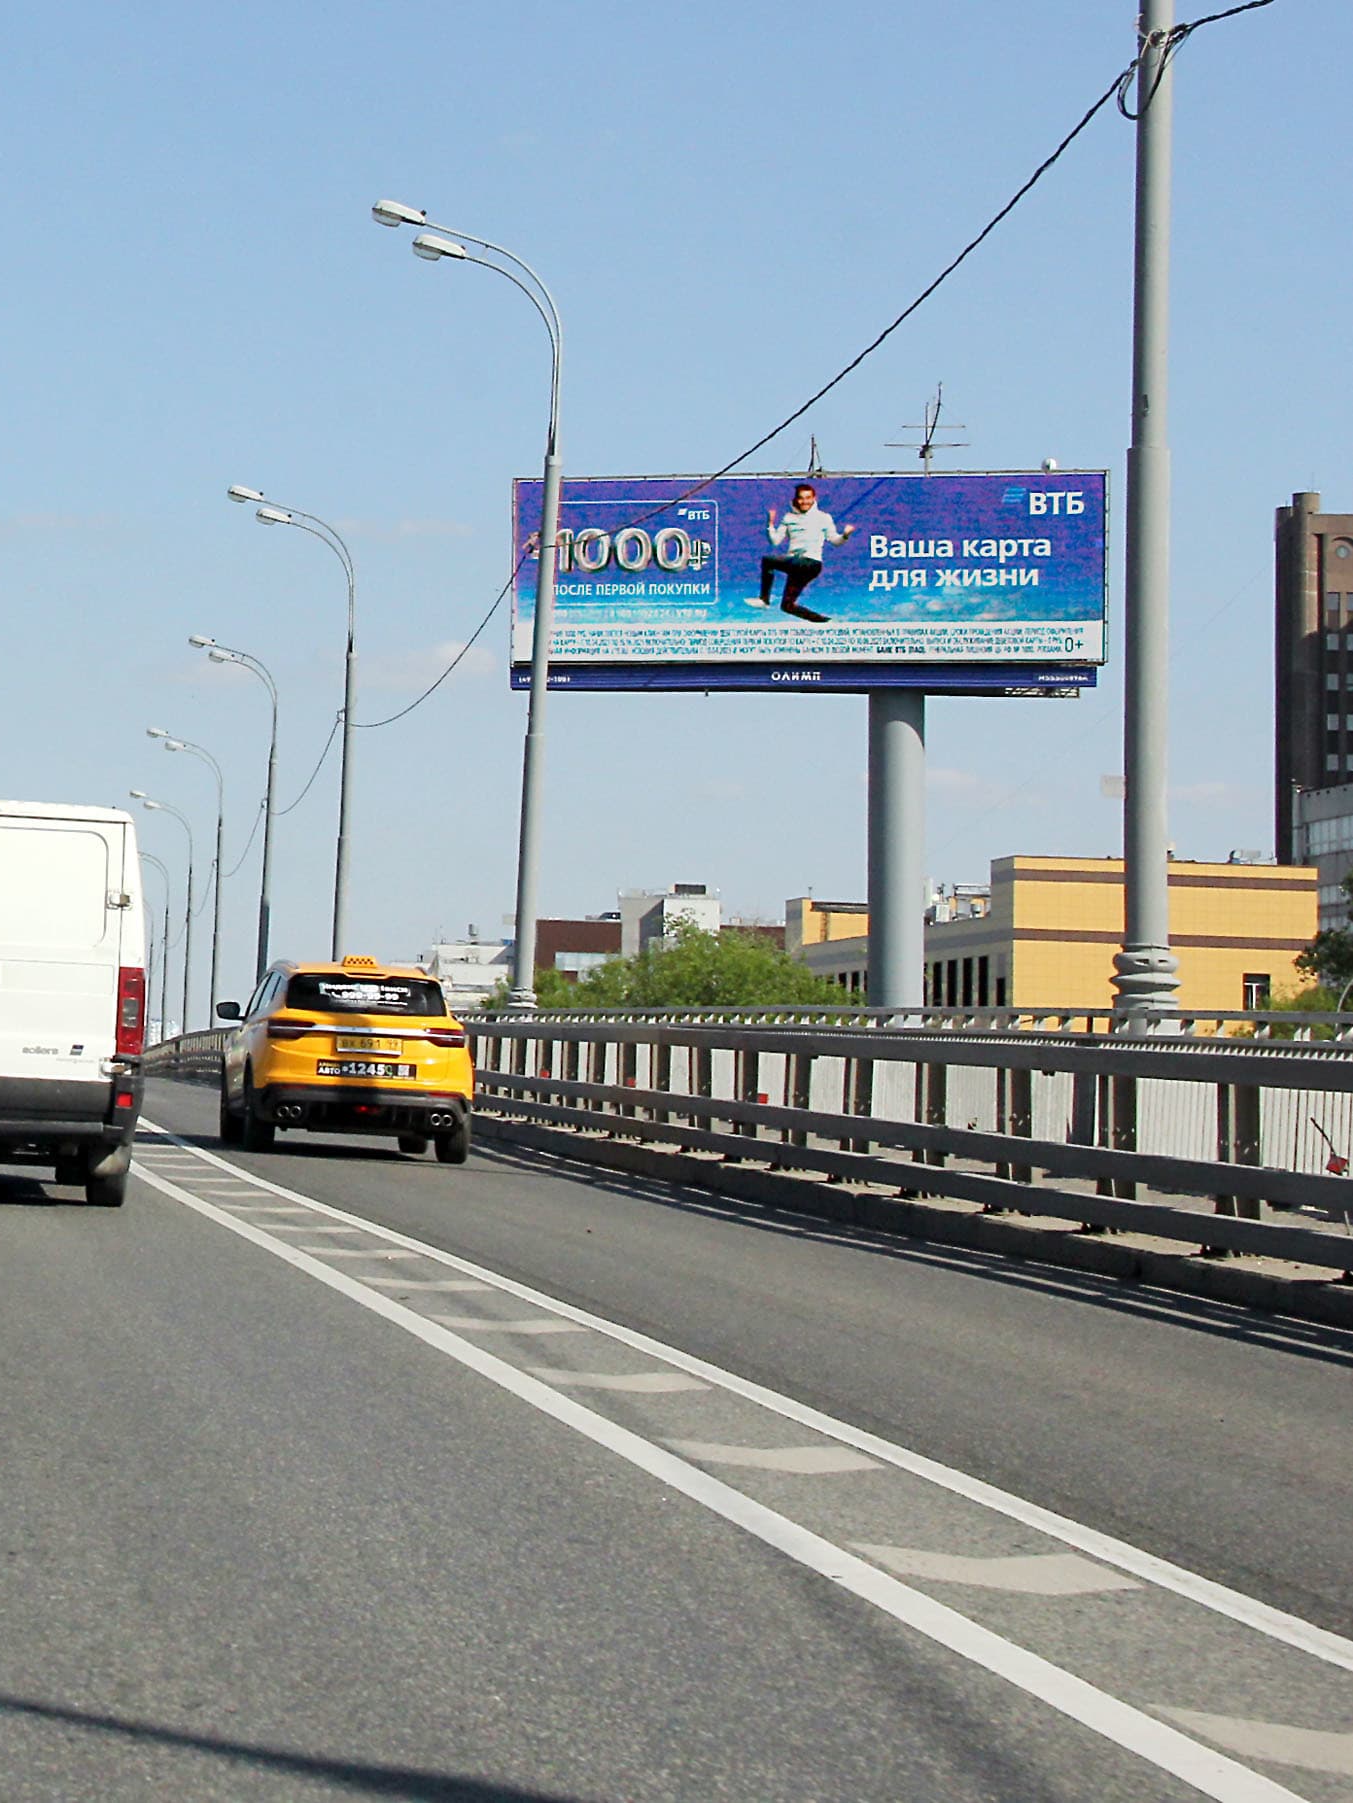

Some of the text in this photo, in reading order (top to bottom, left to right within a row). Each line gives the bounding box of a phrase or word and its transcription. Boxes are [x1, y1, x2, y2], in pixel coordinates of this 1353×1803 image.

[1029, 491, 1085, 515] ВТБ
[687, 509, 711, 521] ВТБ
[870, 534, 1052, 563] Ваша карта
[596, 580, 646, 596] ПЕРВОЙ
[648, 582, 711, 596] ПОКУПКИ
[868, 567, 1039, 592] для жизни
[1064, 636, 1084, 653] 0+
[770, 671, 821, 681] ОЛИМП
